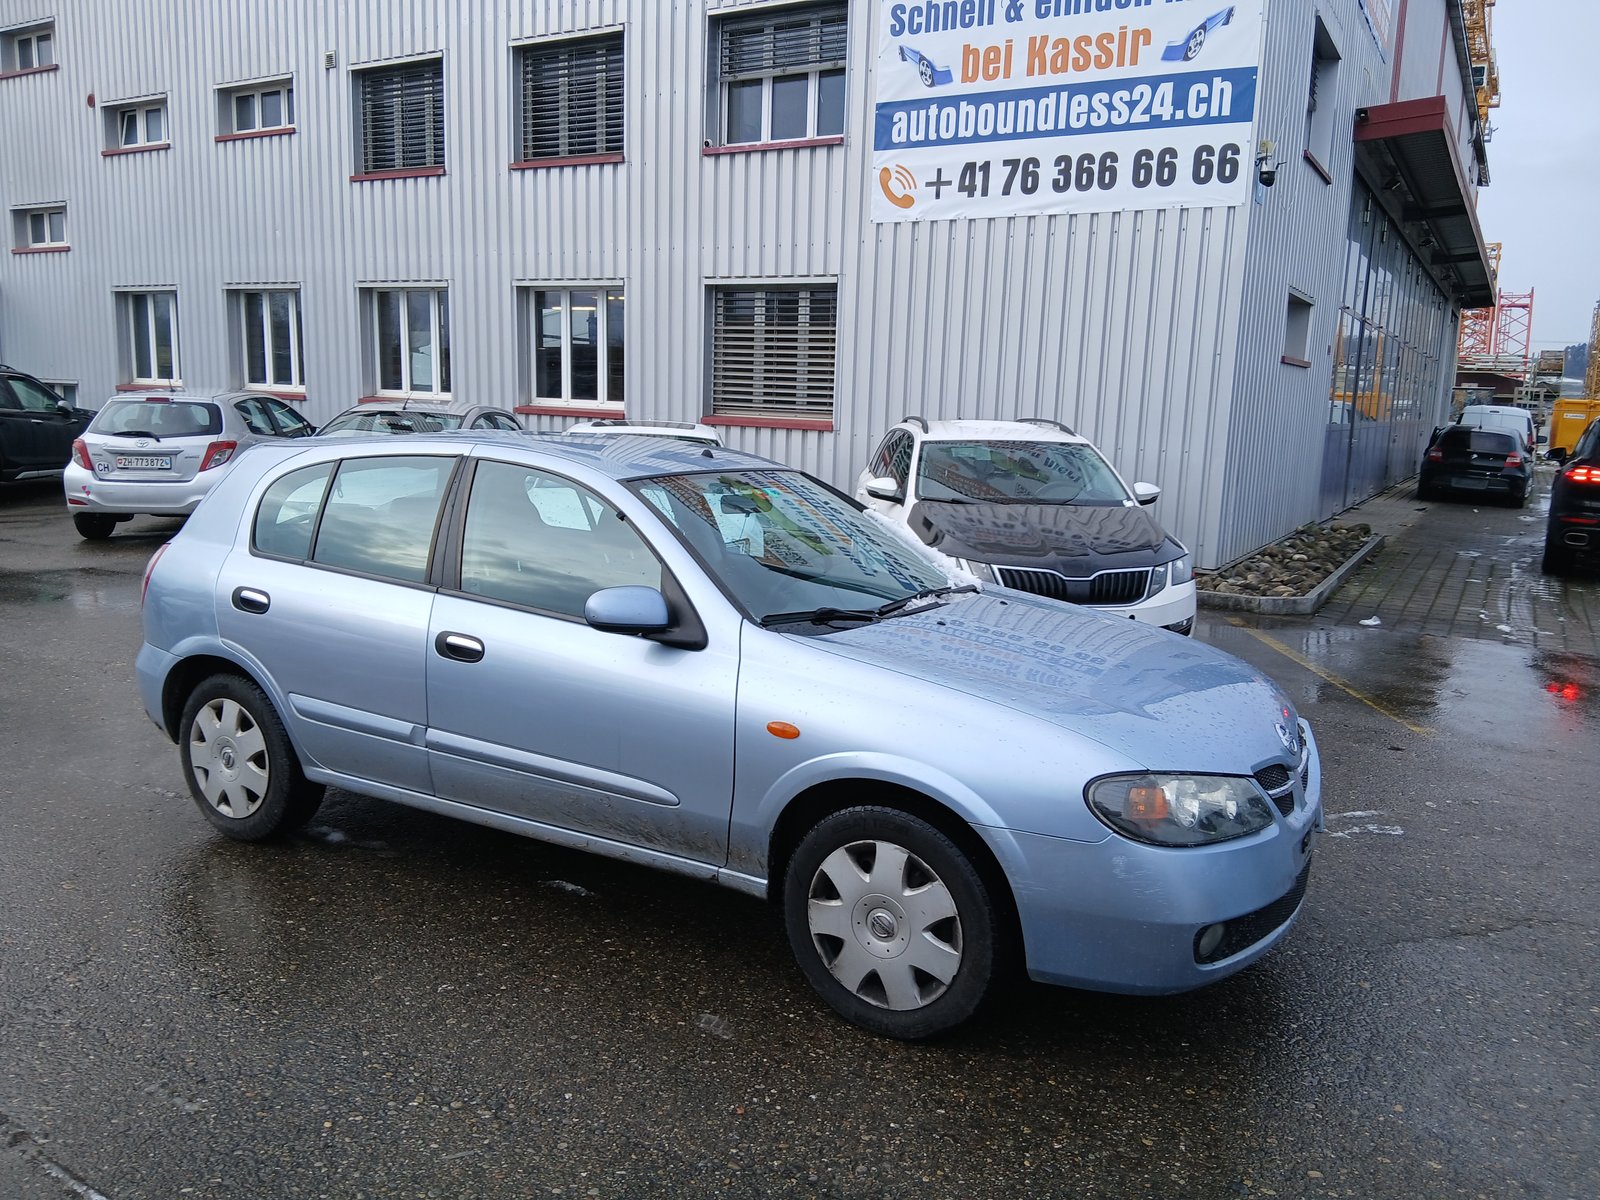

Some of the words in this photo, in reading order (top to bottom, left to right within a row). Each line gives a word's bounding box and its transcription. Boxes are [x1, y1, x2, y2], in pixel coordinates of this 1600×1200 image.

[889, 0, 995, 37] Schnell
[961, 38, 1013, 84] bei
[1026, 25, 1152, 77] Kassir
[891, 76, 1233, 144] autoboundless24.ch
[1001, 156, 1041, 196] 76
[1052, 150, 1119, 194] 366
[1132, 146, 1179, 189] 66
[1191, 142, 1241, 185] 66
[97, 463, 110, 472] CH
